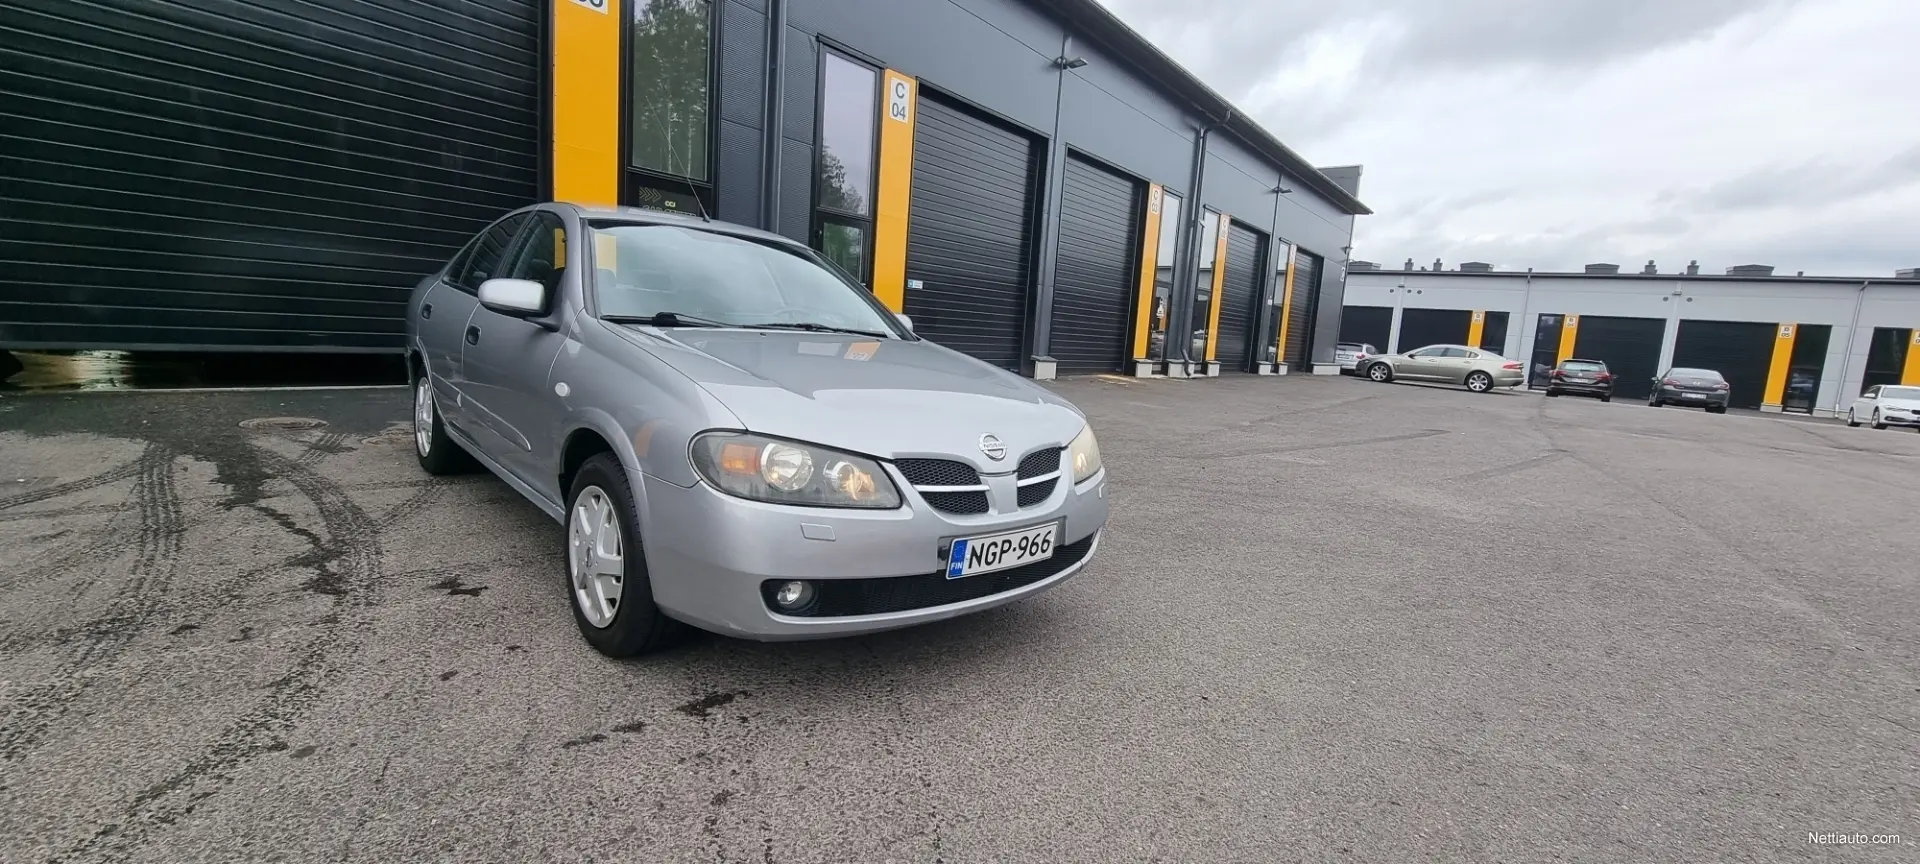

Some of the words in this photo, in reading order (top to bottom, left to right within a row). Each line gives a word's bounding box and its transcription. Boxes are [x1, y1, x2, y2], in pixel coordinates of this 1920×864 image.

[895, 82, 905, 99] C
[892, 102, 906, 120] 04
[968, 530, 1052, 570] NGP-966
[951, 561, 963, 571] FIN
